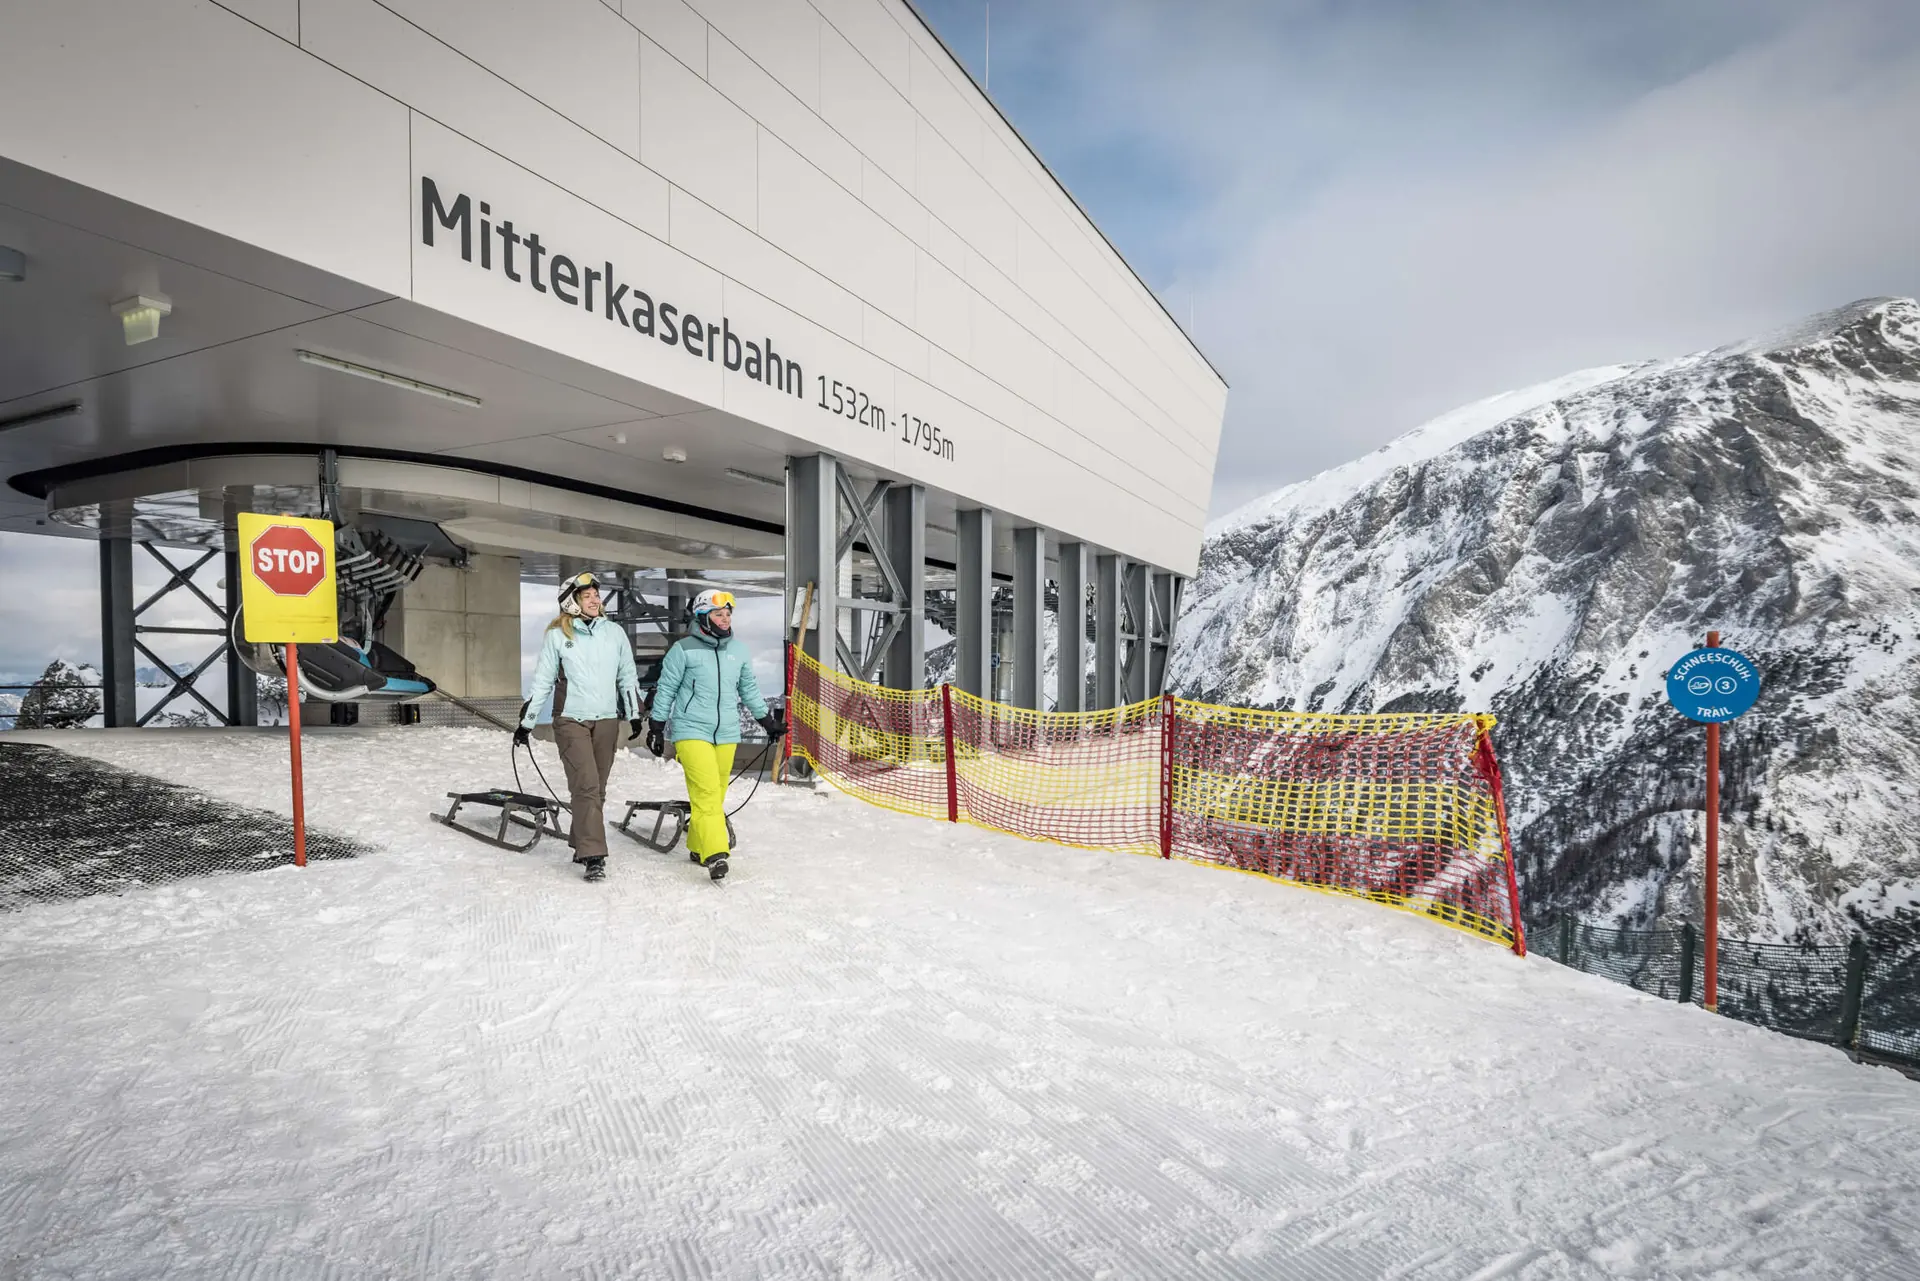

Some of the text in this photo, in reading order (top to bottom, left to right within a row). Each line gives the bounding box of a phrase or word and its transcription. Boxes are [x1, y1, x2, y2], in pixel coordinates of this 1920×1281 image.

[421, 176, 803, 399] Mitterkaserbahn
[817, 375, 886, 432] 1532m
[901, 413, 955, 462] 1795m
[258, 547, 320, 574] STOP
[1721, 681, 1730, 690] 3
[1697, 706, 1733, 718] TRAIL
